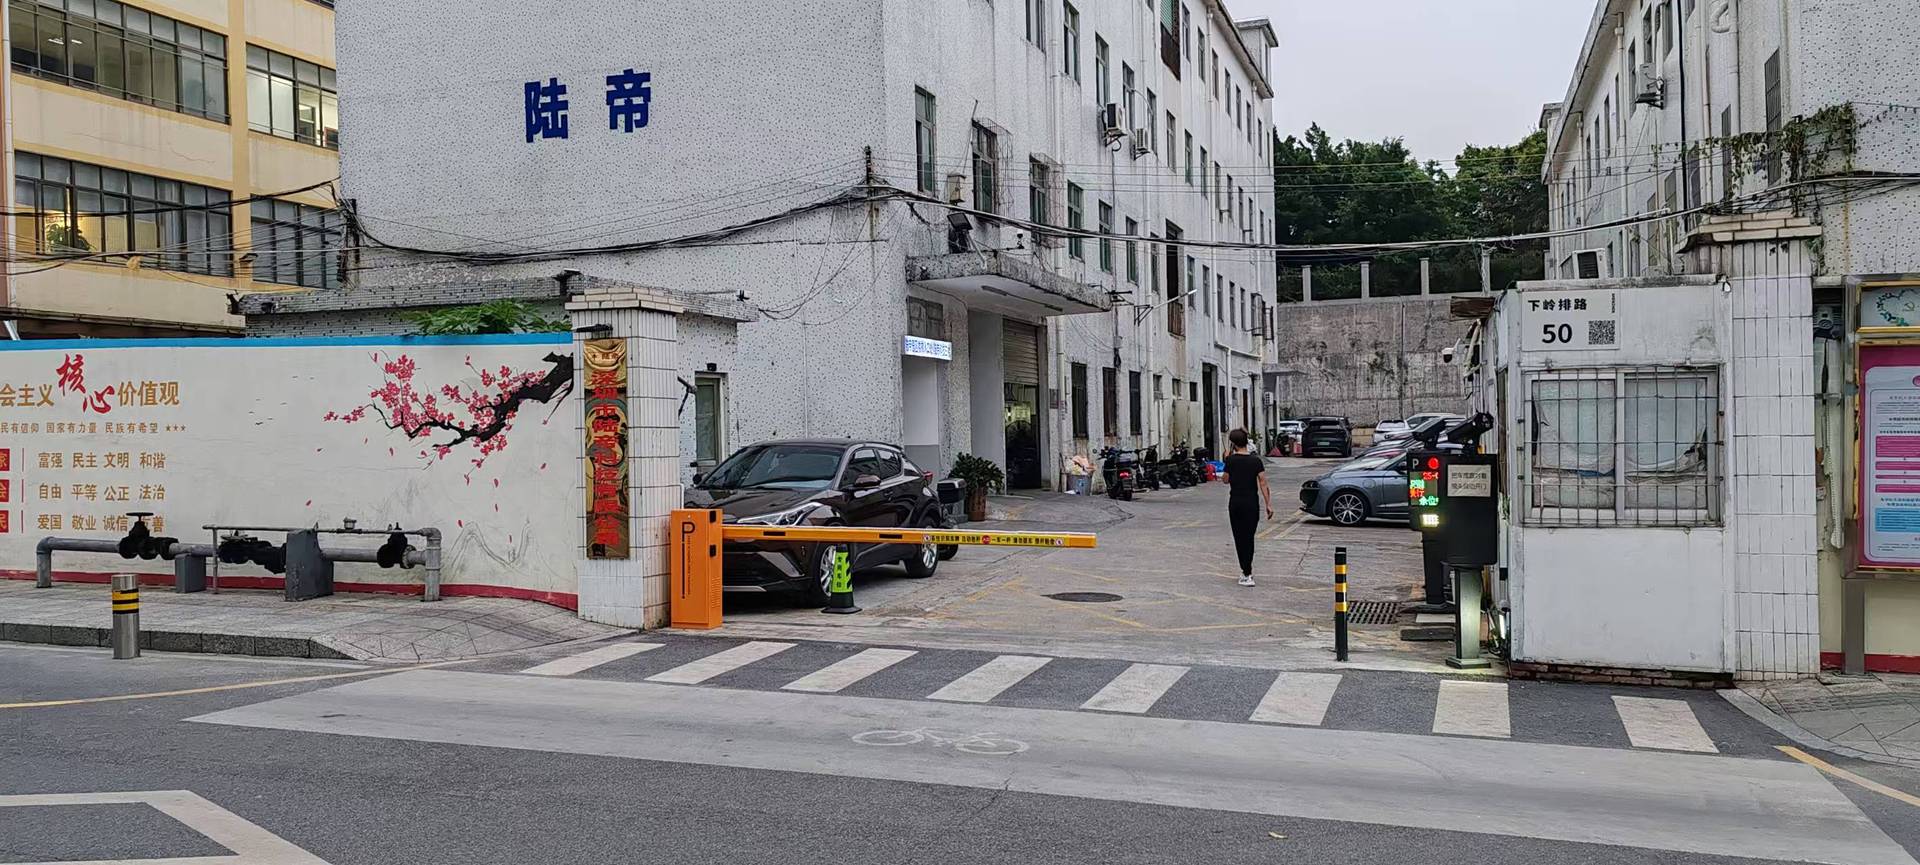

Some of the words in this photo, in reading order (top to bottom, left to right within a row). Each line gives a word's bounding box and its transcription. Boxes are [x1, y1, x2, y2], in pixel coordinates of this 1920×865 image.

[525, 69, 650, 143] 陆帝
[1528, 298, 1587, 312] 下岭排路
[1542, 323, 1572, 343] 50
[0, 422, 40, 434] 民有信仰
[46, 422, 97, 434] 国家有力量
[105, 422, 159, 434] 民族有希望
[38, 452, 63, 468] 富强
[72, 452, 97, 468] 民主
[104, 452, 129, 468] 文明
[140, 452, 165, 469] 和谐
[39, 483, 62, 499] 自由
[71, 484, 97, 500] 平等
[104, 486, 130, 501] 公正
[139, 484, 165, 500] 法治
[38, 514, 62, 530] 爱国
[71, 514, 97, 531] 敬业
[103, 515, 128, 531] 诚信
